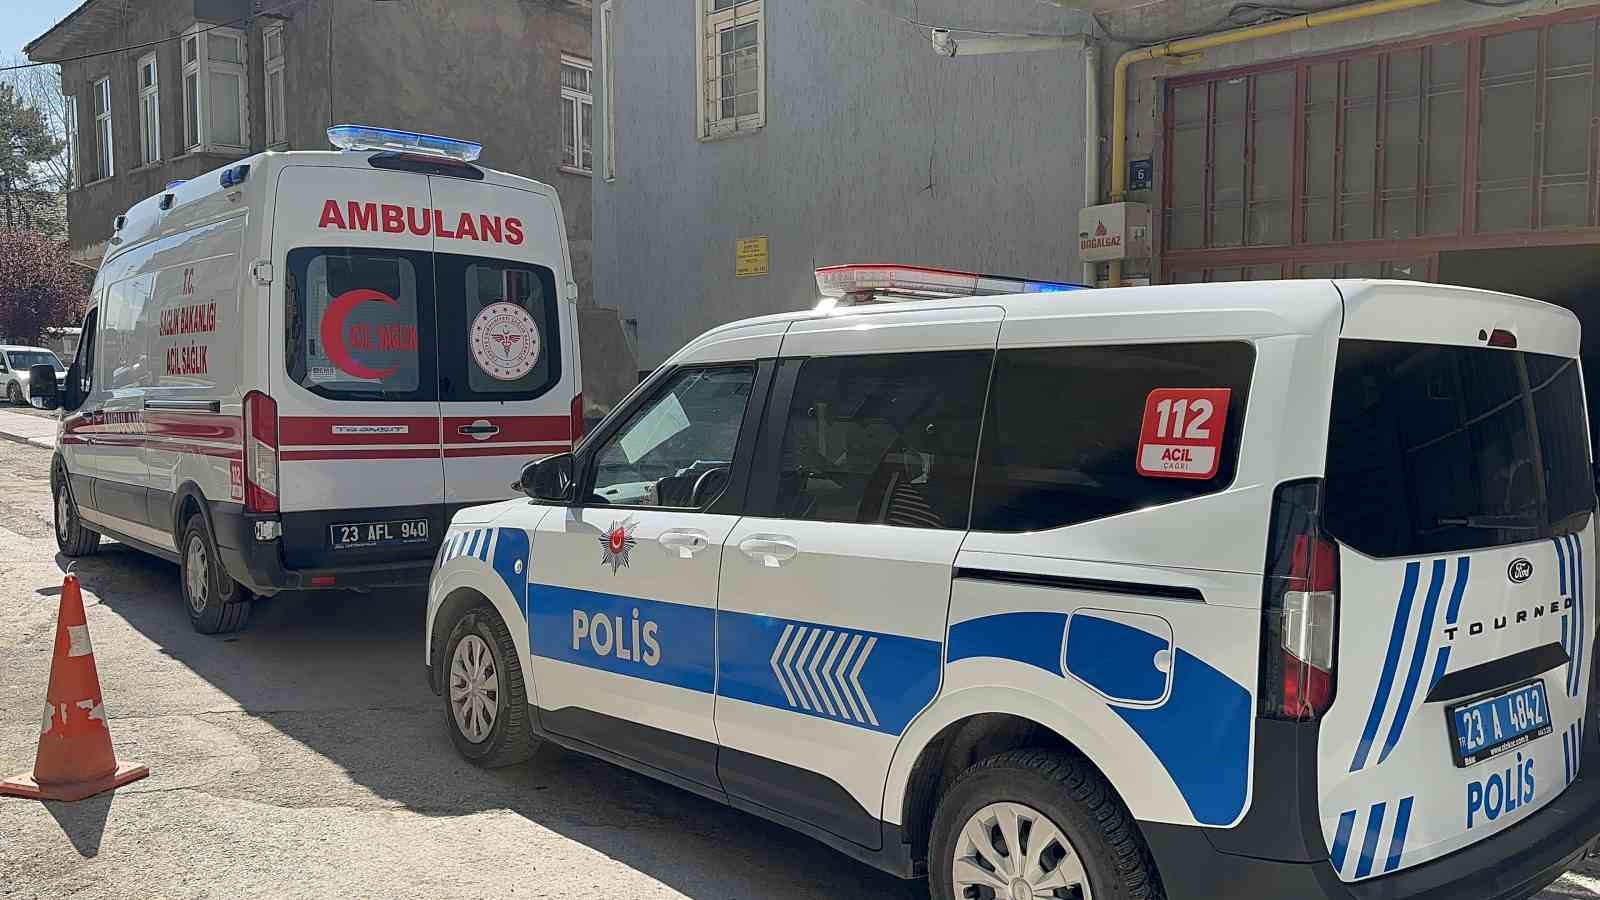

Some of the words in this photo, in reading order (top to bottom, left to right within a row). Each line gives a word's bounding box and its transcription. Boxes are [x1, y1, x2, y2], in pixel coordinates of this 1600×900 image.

[1137, 168, 1145, 180] 6
[319, 199, 523, 246] AMBULANS
[1156, 398, 1214, 439] 112
[341, 526, 359, 543] 23
[367, 523, 394, 541] AFL
[401, 521, 427, 538] 940
[572, 607, 661, 667] POLİS
[1463, 709, 1485, 750] 23
[1491, 703, 1503, 740] A
[1508, 689, 1544, 732] 4842
[1466, 751, 1535, 830] POLİS
